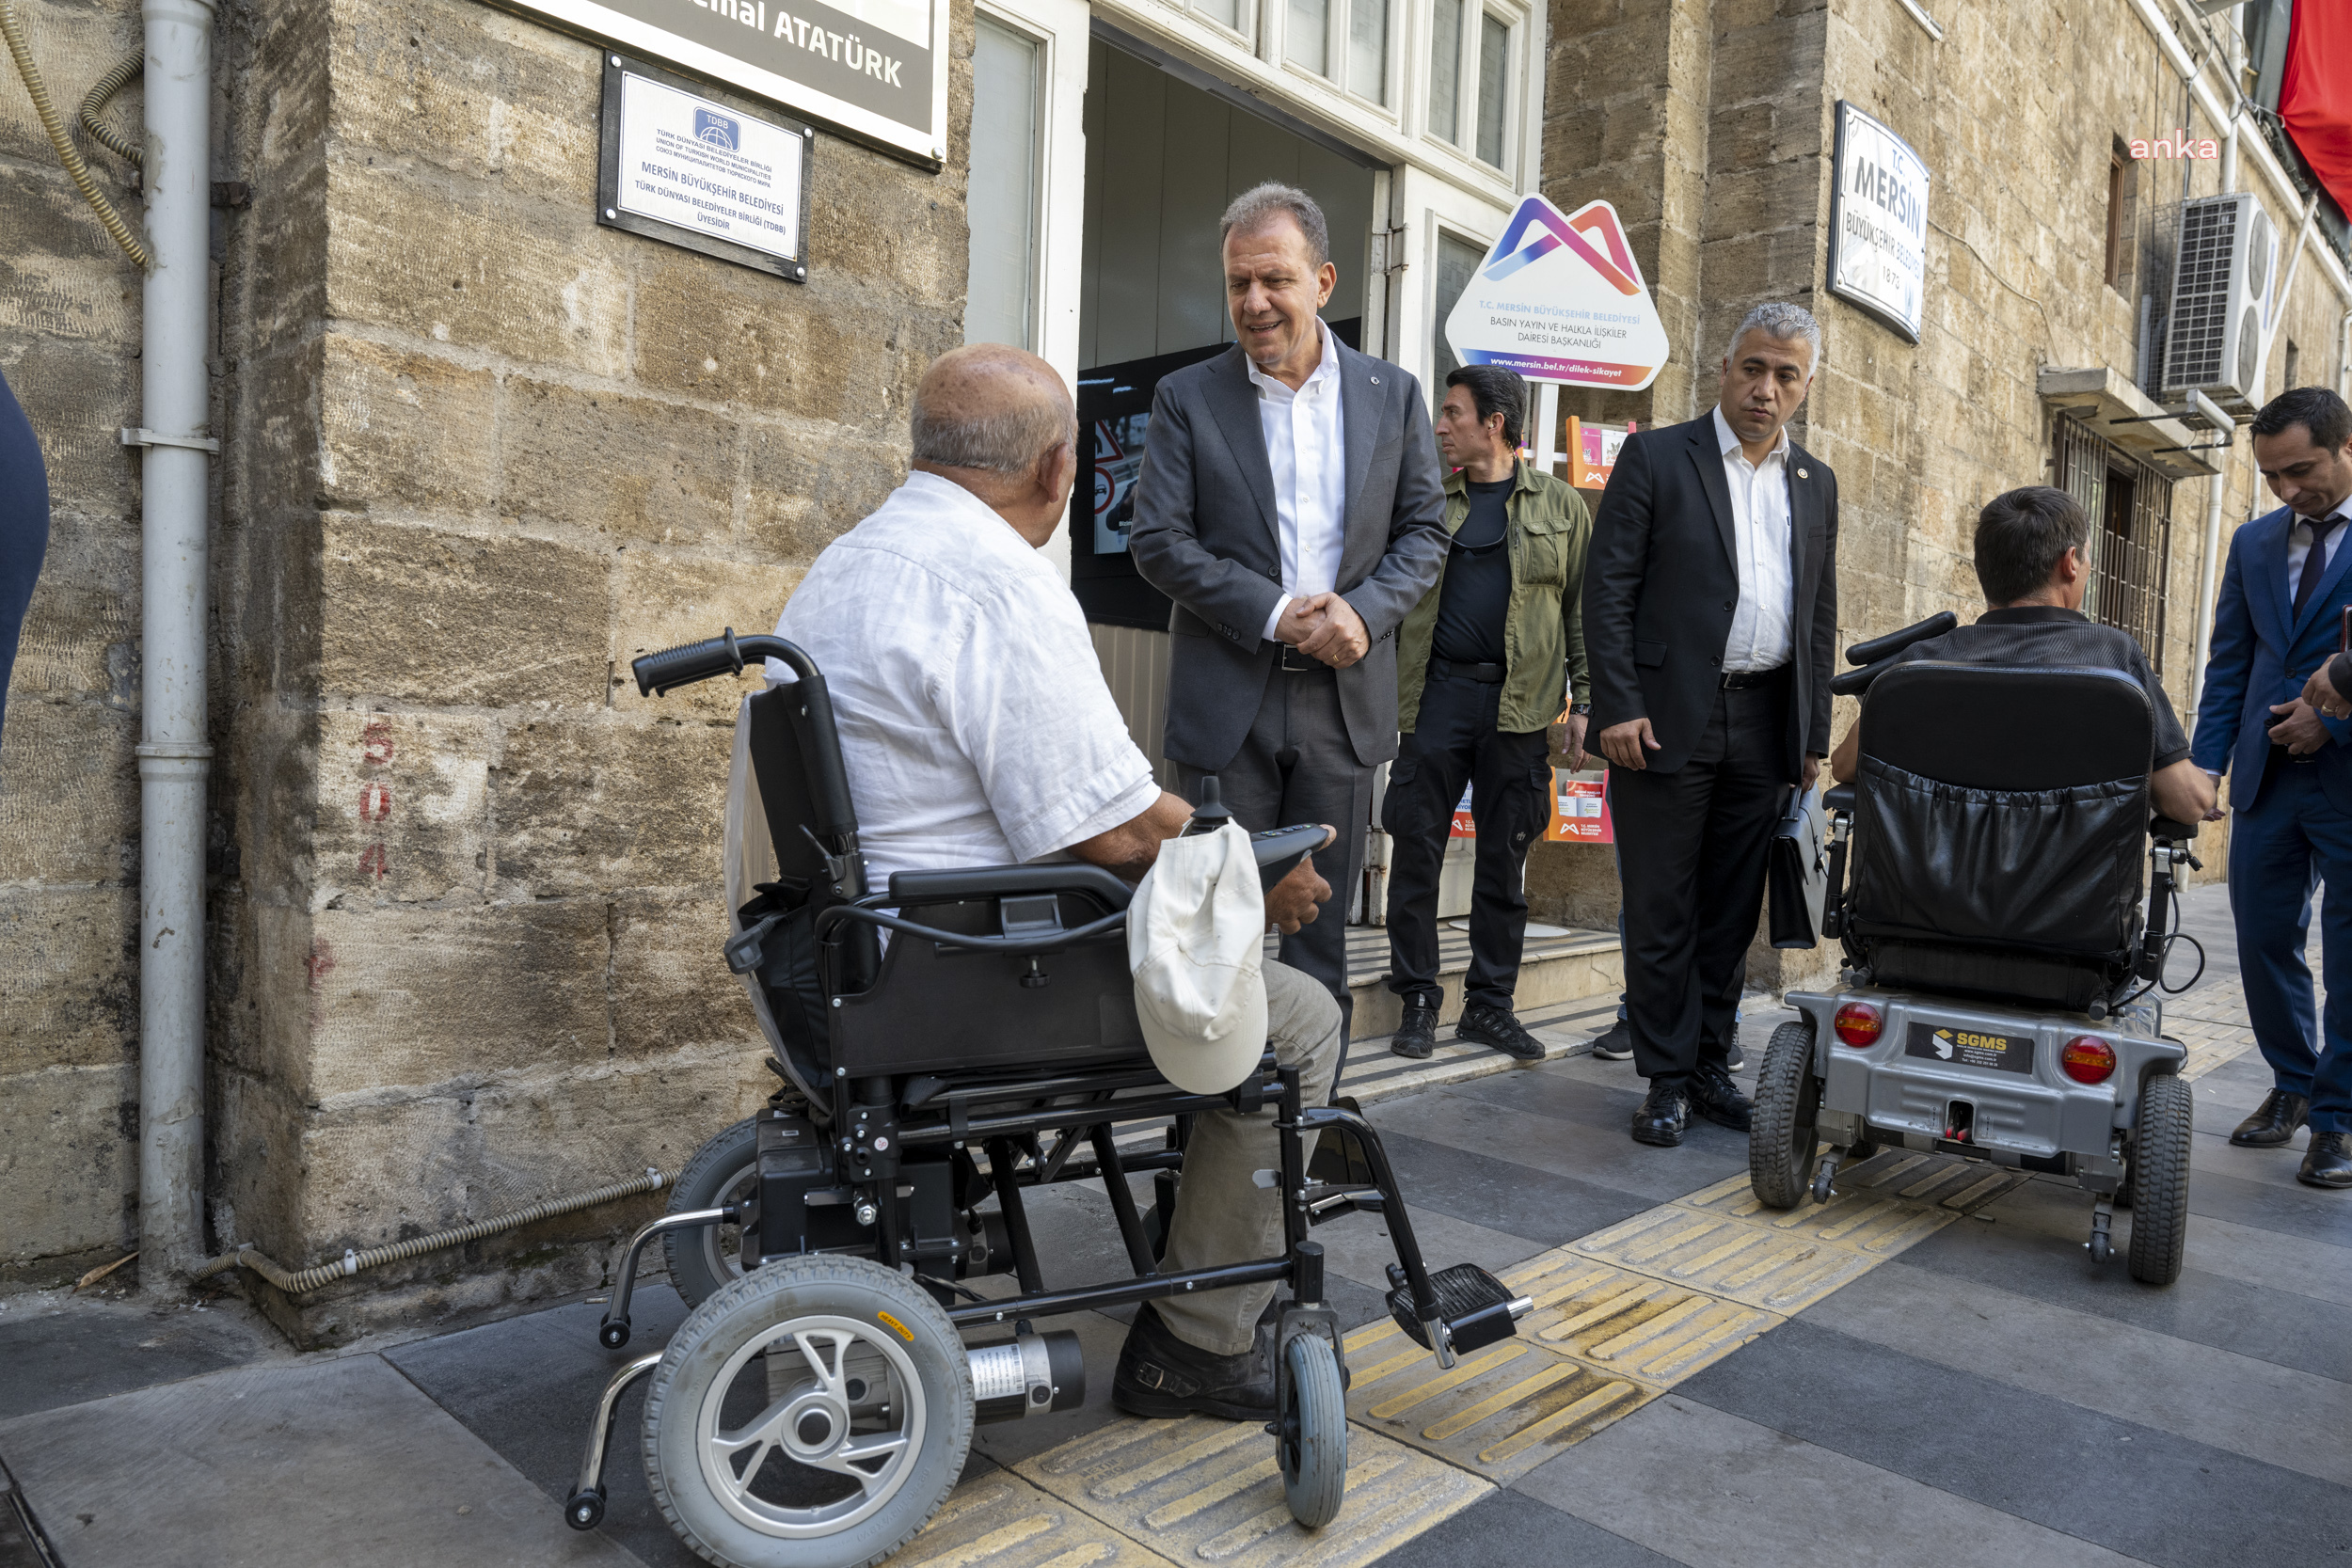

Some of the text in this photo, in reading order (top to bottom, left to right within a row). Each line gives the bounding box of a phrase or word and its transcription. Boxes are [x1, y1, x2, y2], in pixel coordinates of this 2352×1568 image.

[773, 11, 902, 88] ATATÜRK
[707, 114, 729, 130] TDBB
[656, 137, 771, 181] UNION OF TURKISH WORLD MUNICIPALITIES
[657, 128, 772, 173] TÜRK DÜNYASI BELEDİYELER BİRLİĞİ
[1891, 149, 1906, 178] T.C.
[656, 146, 771, 189] СОЮЗ МУНИЦИПАЛИТЕТОВ ТЮРКСКОГО МИРА
[642, 161, 784, 216] MERSİN BÜYÜKŞEHİR BELEDİYESİ
[1853, 155, 1921, 239] MERSİN
[635, 180, 787, 236] TÜRK DÜNYASI BELEDİYELER BİRLİĞİ (TDBB)
[697, 212, 730, 230] ÜYESİDİR
[1846, 209, 1896, 259] BÜYÜKŞEHİR
[1883, 265, 1900, 290] 1873
[1479, 300, 1641, 325] T.C. MERSİN BÜYÜKŞEHİR BELEDİYESİ
[1490, 316, 1628, 339] BASIN YAYIN VE HALKLA İLİŞKİLER
[1518, 332, 1601, 349] DAİRESİ BAŞKANLIĞI
[1490, 357, 1623, 377] www.mersin.bel.tr/dilek-sikayet
[1957, 1032, 2007, 1051] SGMS
[880, 1313, 912, 1338] HEAVY DUTY
